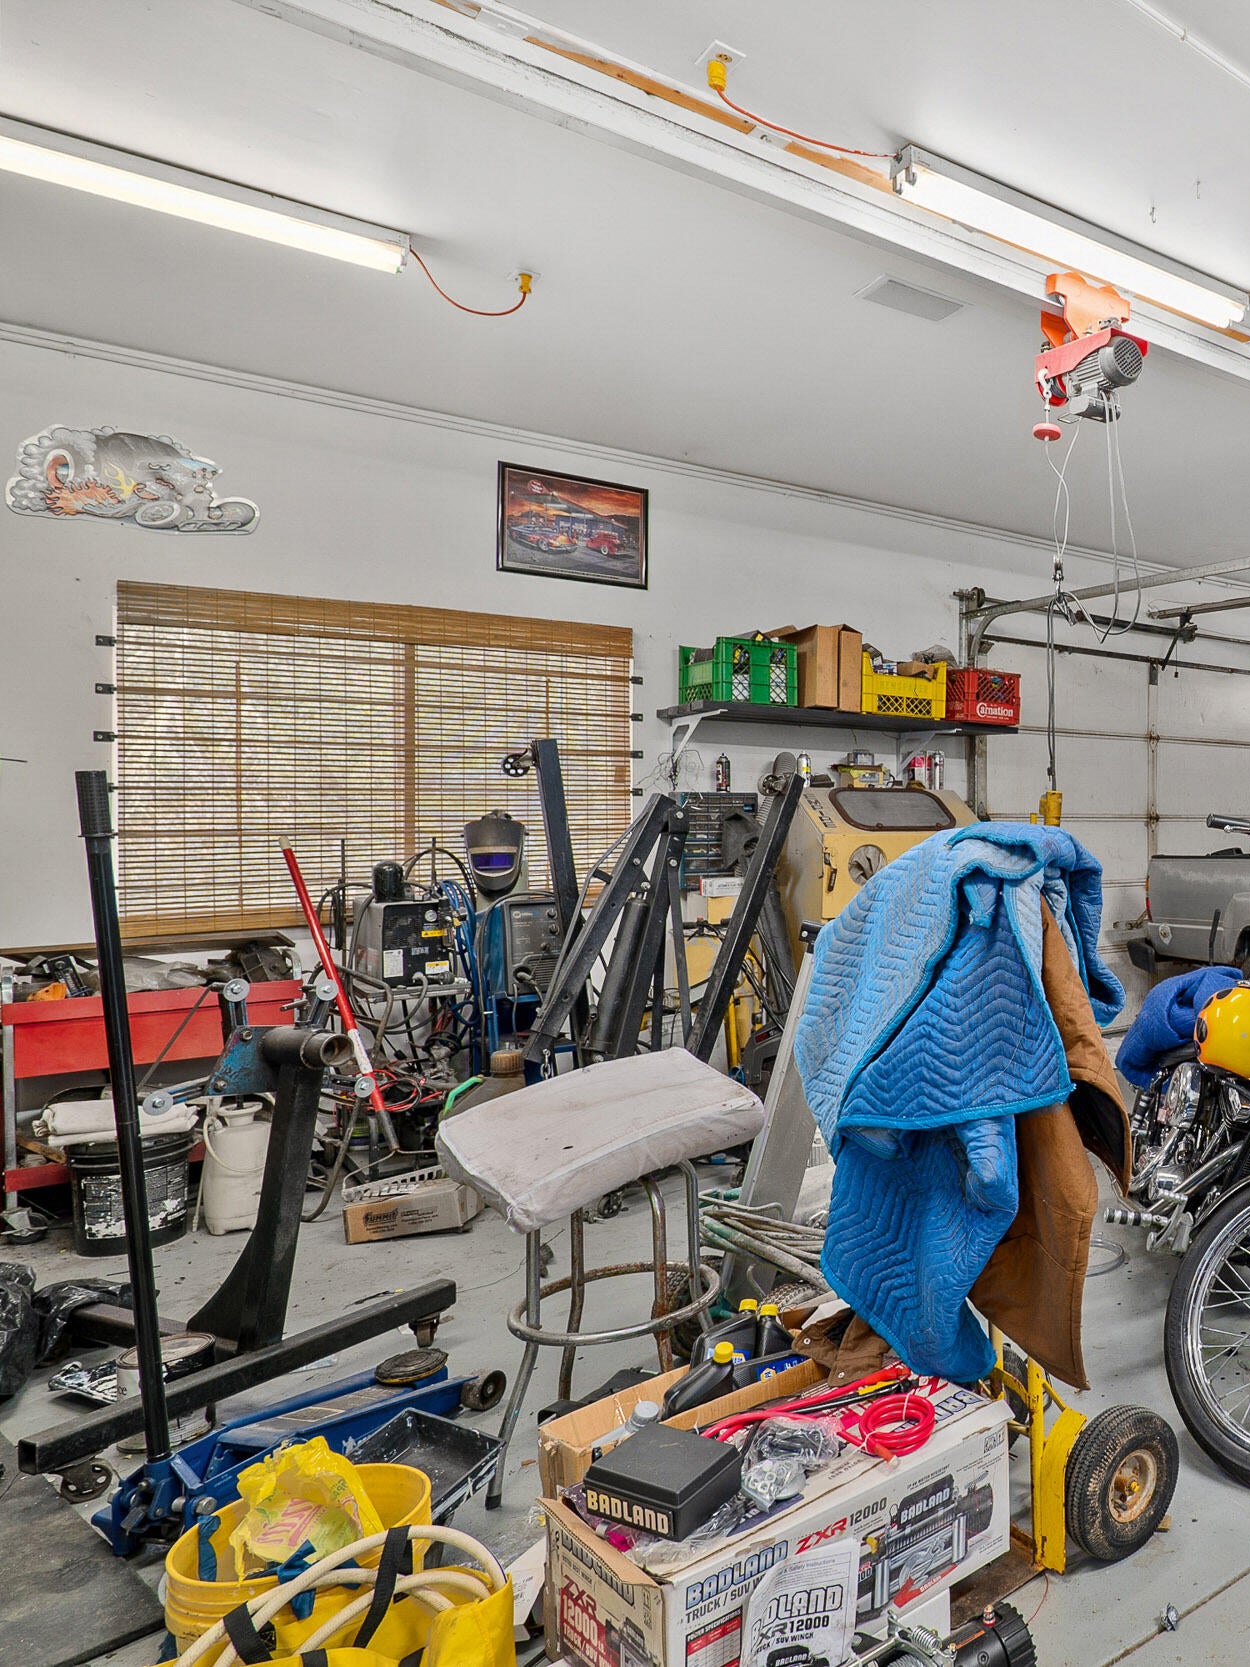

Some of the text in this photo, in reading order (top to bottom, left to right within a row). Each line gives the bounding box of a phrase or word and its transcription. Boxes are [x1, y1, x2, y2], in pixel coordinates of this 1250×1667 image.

[976, 702, 1014, 718] Carnation
[586, 1489, 669, 1535] BADLAND
[900, 1487, 950, 1524] BADLAND
[686, 1540, 788, 1610] BADLAND
[795, 1517, 848, 1555] ZXR
[850, 1497, 887, 1527] 12000
[564, 1574, 597, 1614] ZXR
[686, 1596, 721, 1624] TRUCK
[730, 1580, 751, 1601] SUV
[563, 1594, 598, 1648] 12000
[758, 1615, 830, 1644] XR 12000
[776, 1636, 789, 1645] SUV
[790, 1632, 814, 1643] WINCH
